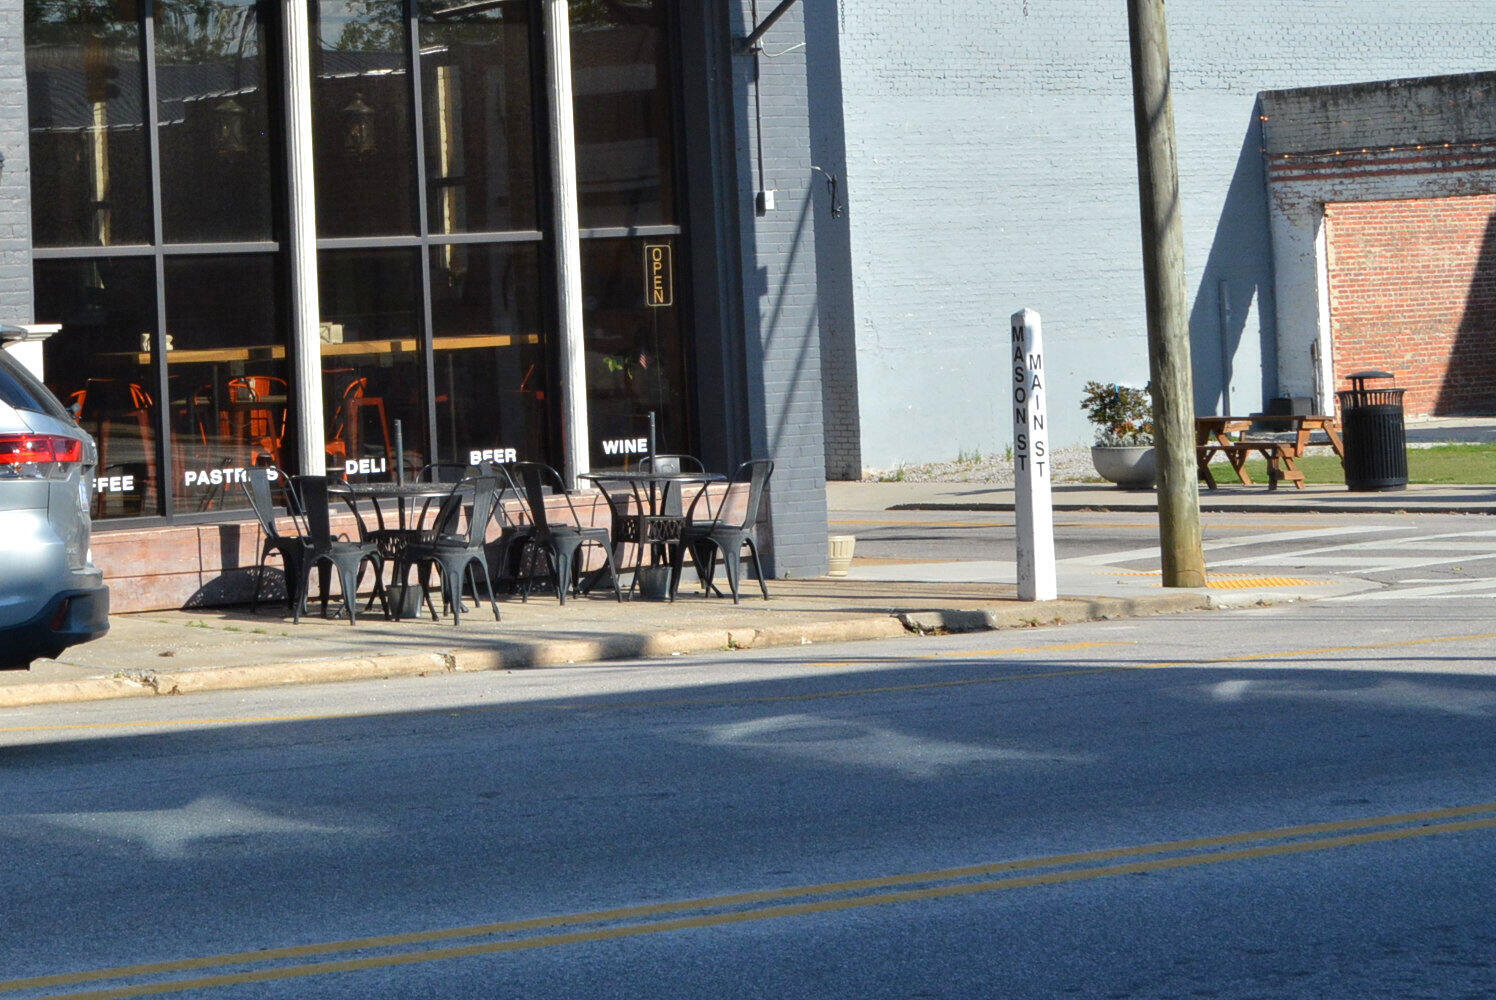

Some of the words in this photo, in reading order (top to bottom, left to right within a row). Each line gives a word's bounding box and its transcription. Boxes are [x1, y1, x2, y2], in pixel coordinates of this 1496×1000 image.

[652, 248, 664, 304] OPEN
[1012, 326, 1026, 425] MASON
[1029, 354, 1044, 431] MAIN
[470, 448, 517, 466] BEER
[602, 438, 648, 455] WINE
[1017, 434, 1027, 471] ST
[1035, 441, 1045, 478] ST
[185, 467, 279, 487] PASTRS
[345, 457, 386, 475] DELI
